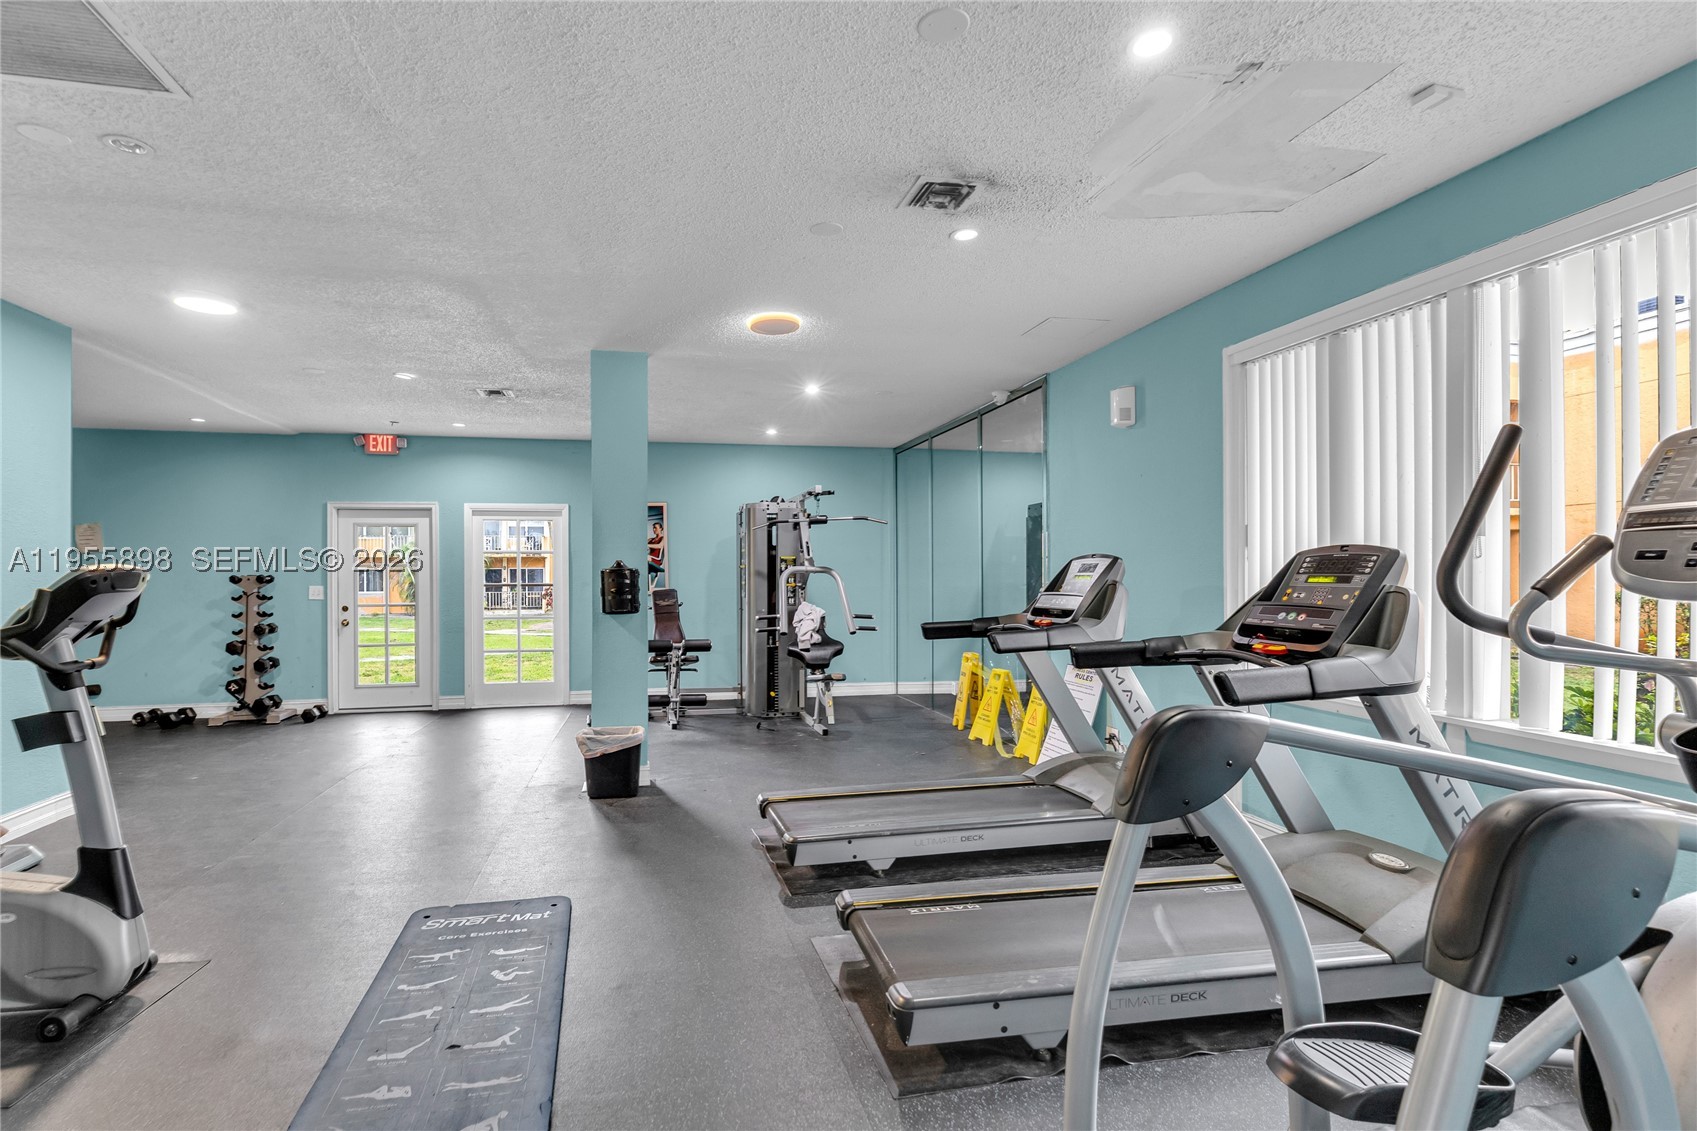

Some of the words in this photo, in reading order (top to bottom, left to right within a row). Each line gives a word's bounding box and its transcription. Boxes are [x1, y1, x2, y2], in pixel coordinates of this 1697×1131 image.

[369, 434, 394, 452] EXIT
[1074, 672, 1093, 682] RULES
[913, 836, 959, 847] ULTIMATE
[960, 834, 984, 842] DECK
[421, 914, 510, 930] Smart
[510, 910, 553, 922] Mat
[470, 928, 528, 938] Exercises
[1170, 990, 1208, 1003] DECK
